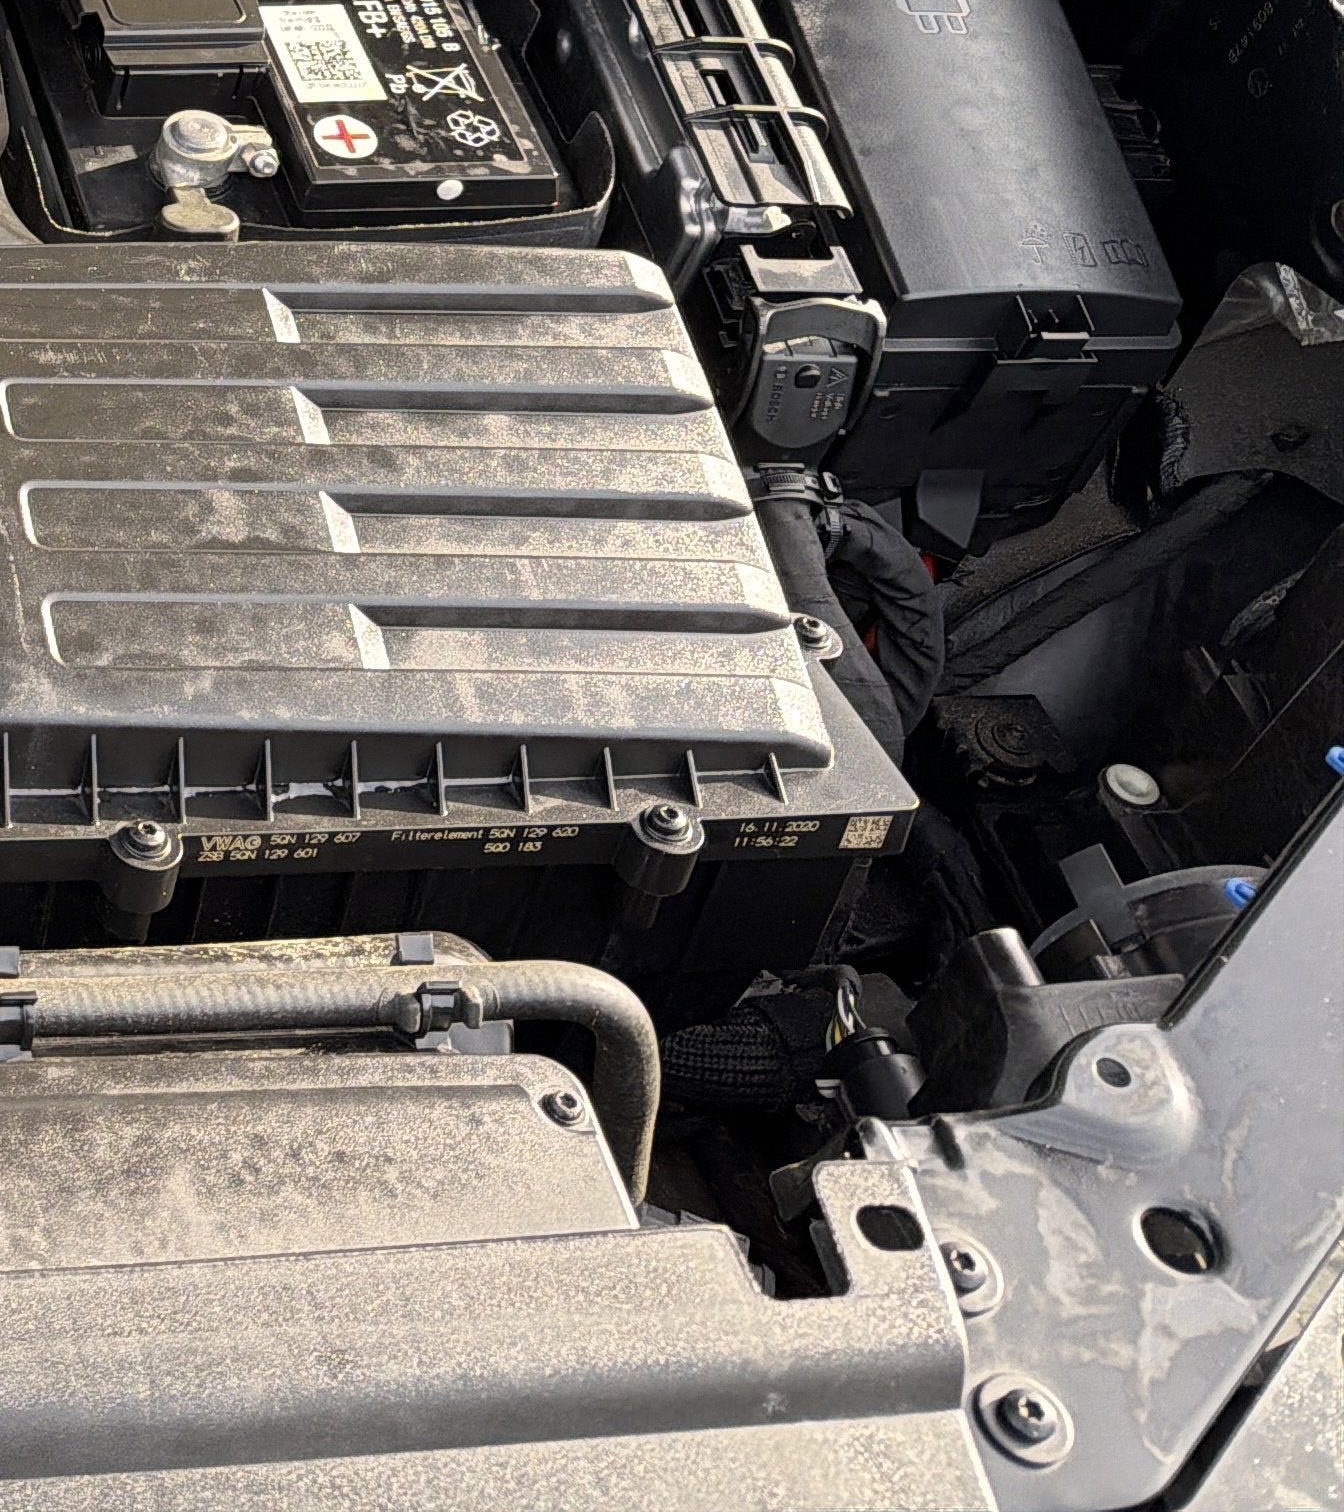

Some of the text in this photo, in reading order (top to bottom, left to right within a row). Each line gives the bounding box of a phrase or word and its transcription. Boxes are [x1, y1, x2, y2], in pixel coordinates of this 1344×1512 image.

[441, 42, 462, 52] B
[384, 72, 407, 95] Pb
[766, 382, 784, 423] BOSCH
[304, 833, 329, 845] 129
[333, 832, 362, 844] 607
[389, 828, 484, 842] Filterelement
[522, 827, 548, 838] 129
[551, 826, 580, 838] 620
[733, 835, 799, 848] 11:56:22
[197, 850, 224, 862] ZSB
[264, 848, 289, 860] 129
[293, 847, 319, 859] 601
